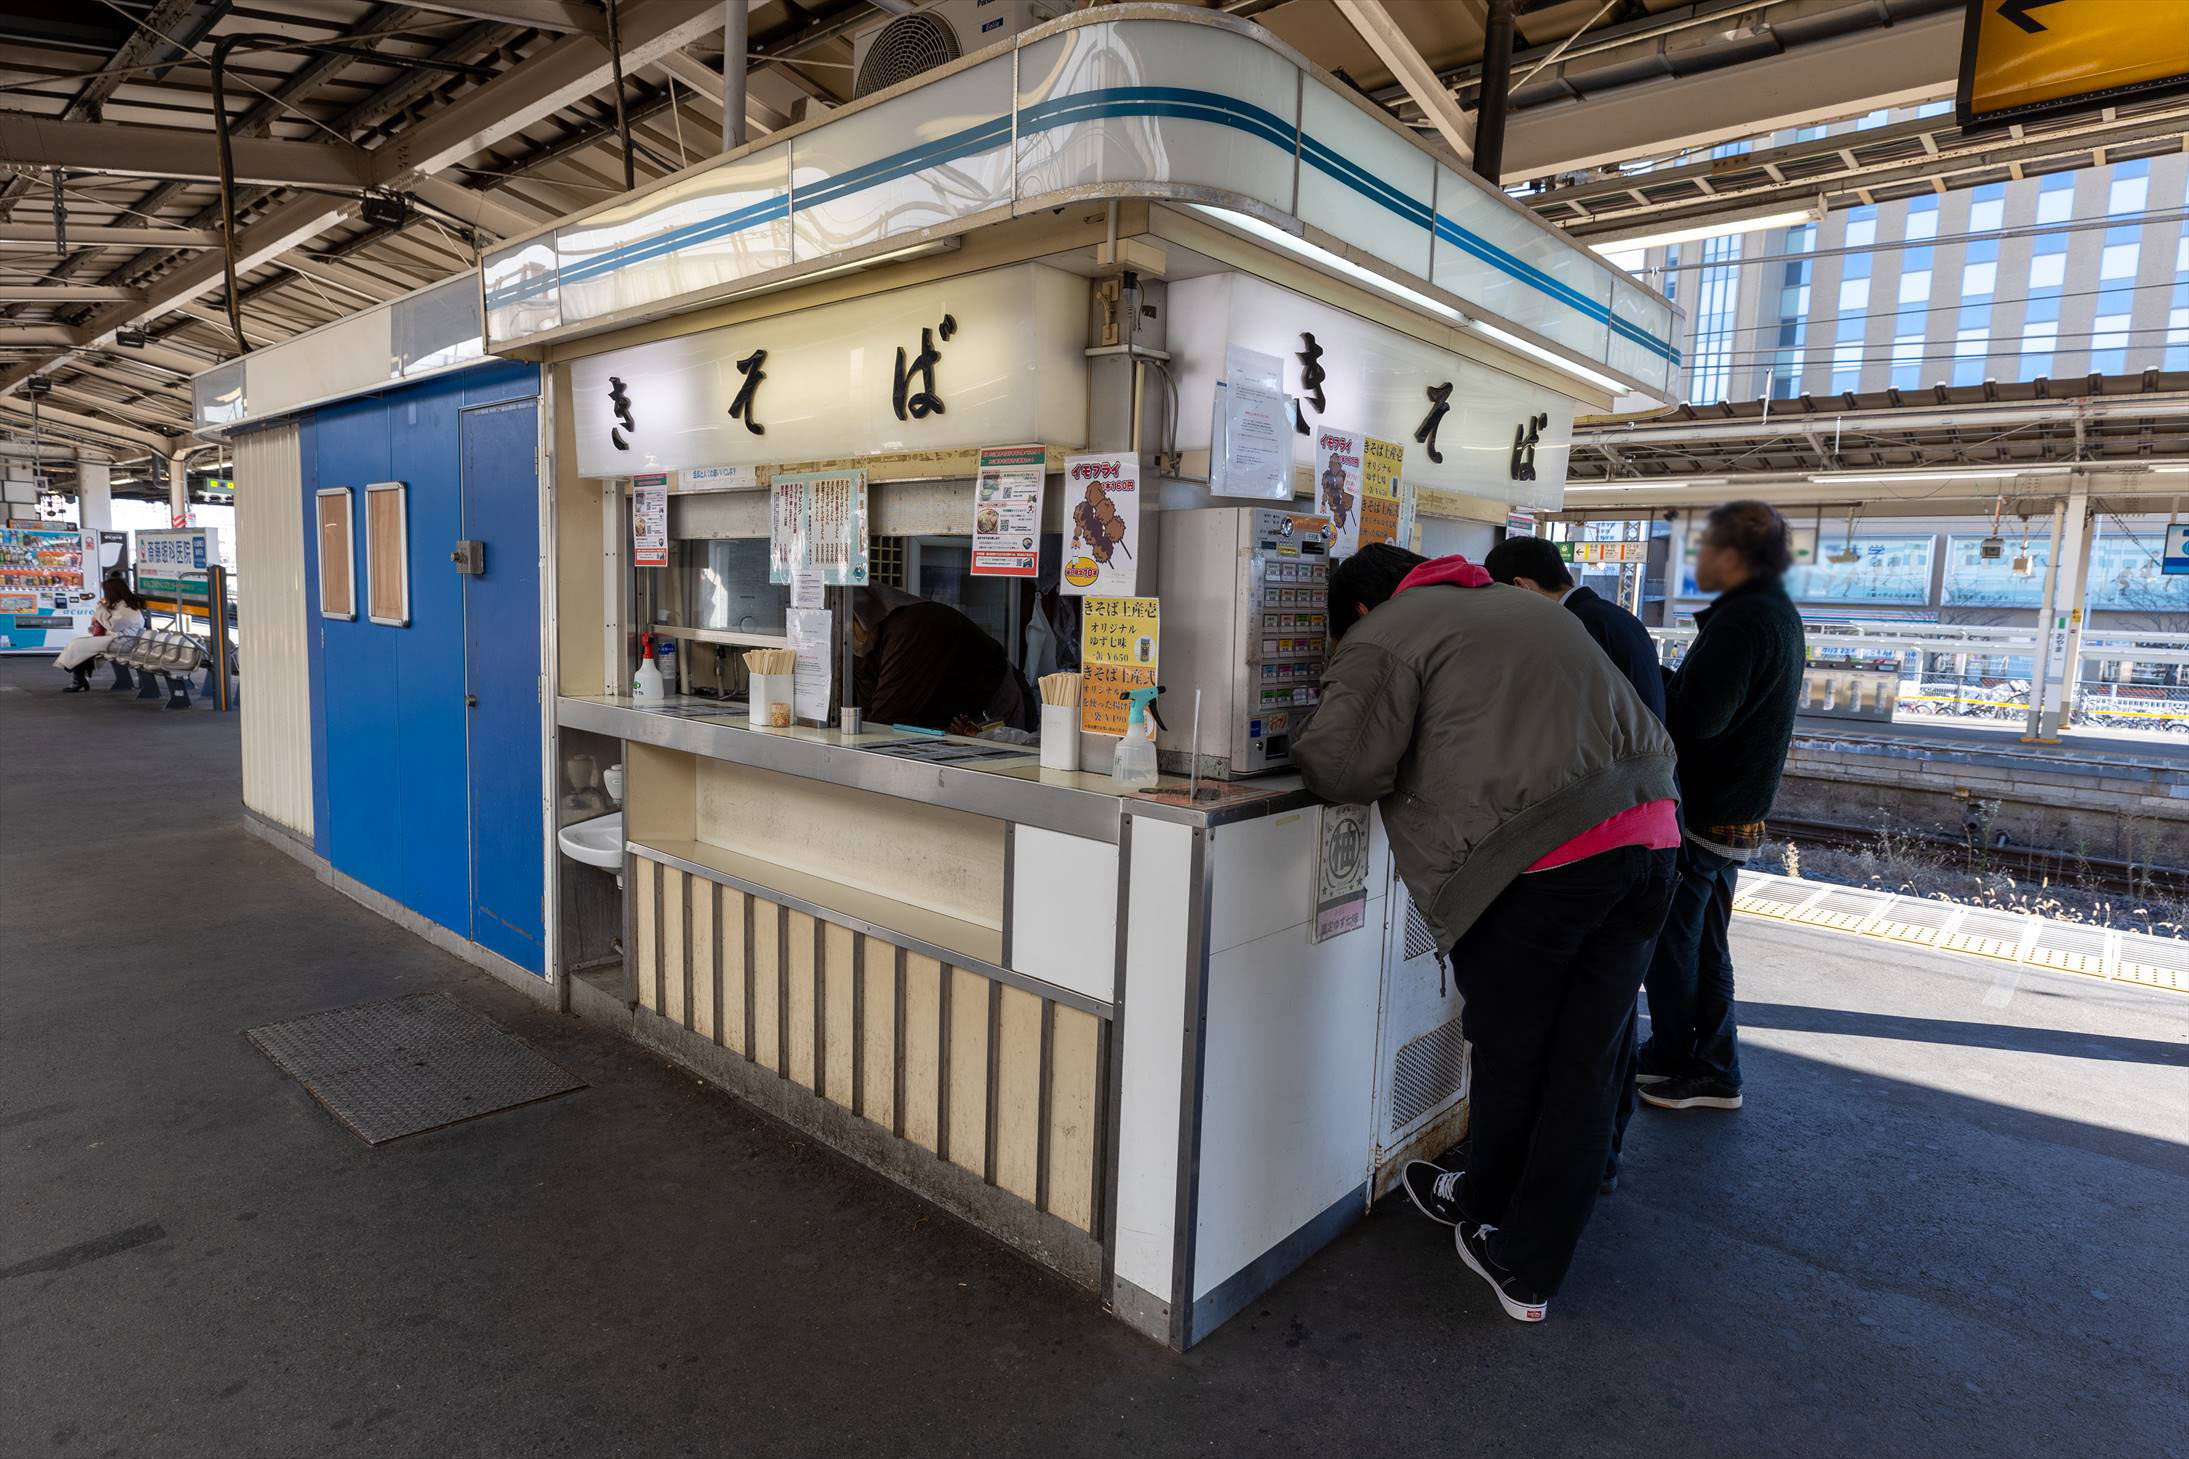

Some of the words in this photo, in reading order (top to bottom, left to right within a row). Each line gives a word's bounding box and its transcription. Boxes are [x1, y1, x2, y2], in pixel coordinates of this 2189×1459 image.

[608, 314, 957, 451] きそば
[1294, 332, 1544, 480] きそば
[1320, 434, 1352, 454] イモフライ
[1071, 462, 1121, 480] イモフライ
[1367, 461, 1392, 474] オリジナル
[1084, 601, 1157, 618] きそば土産壱
[1090, 622, 1136, 634] オリジナル
[1090, 636, 1127, 649] ゆず七味
[2056, 633, 2065, 652] おやま
[1083, 698, 1132, 711] を使った揚げ
